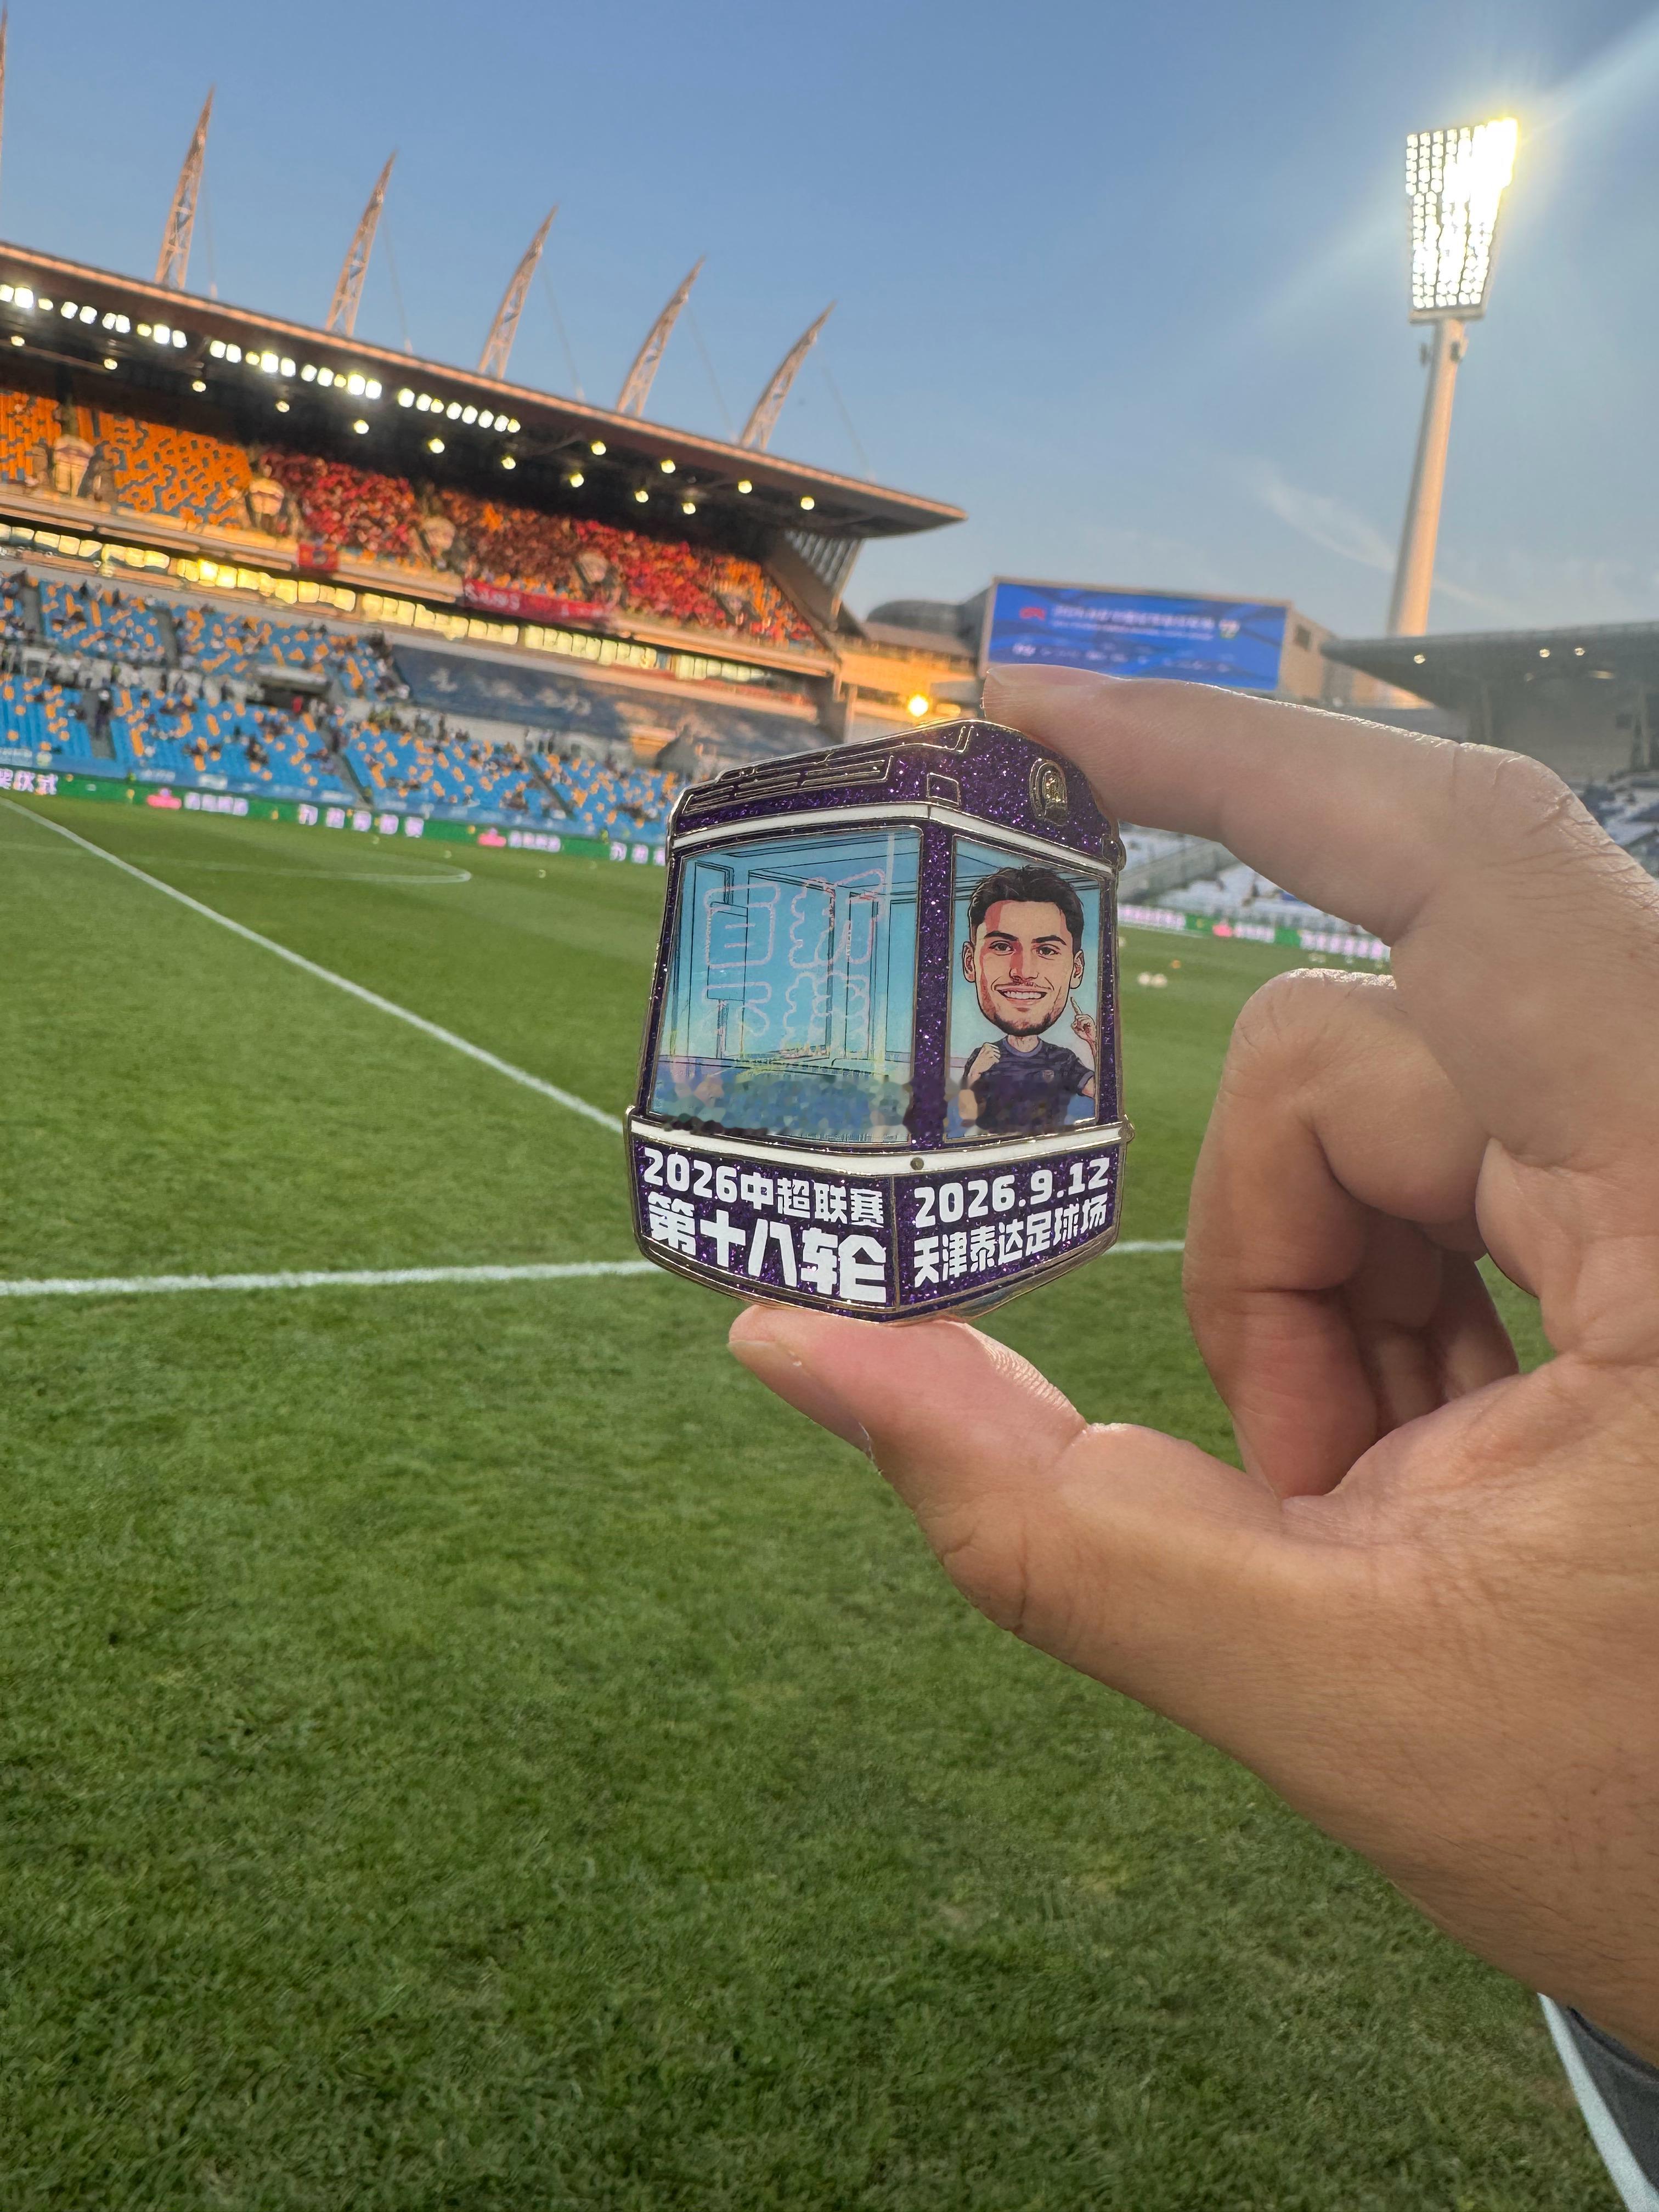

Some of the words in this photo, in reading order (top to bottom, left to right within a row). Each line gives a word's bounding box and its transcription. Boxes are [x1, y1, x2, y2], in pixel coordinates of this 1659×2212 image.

[644, 1147, 884, 1228] 2026中超联赛
[914, 1157, 1110, 1228] 2026.9.12
[648, 1192, 887, 1303] 第十八轮
[914, 1193, 1108, 1288] 天津泰达足球场
